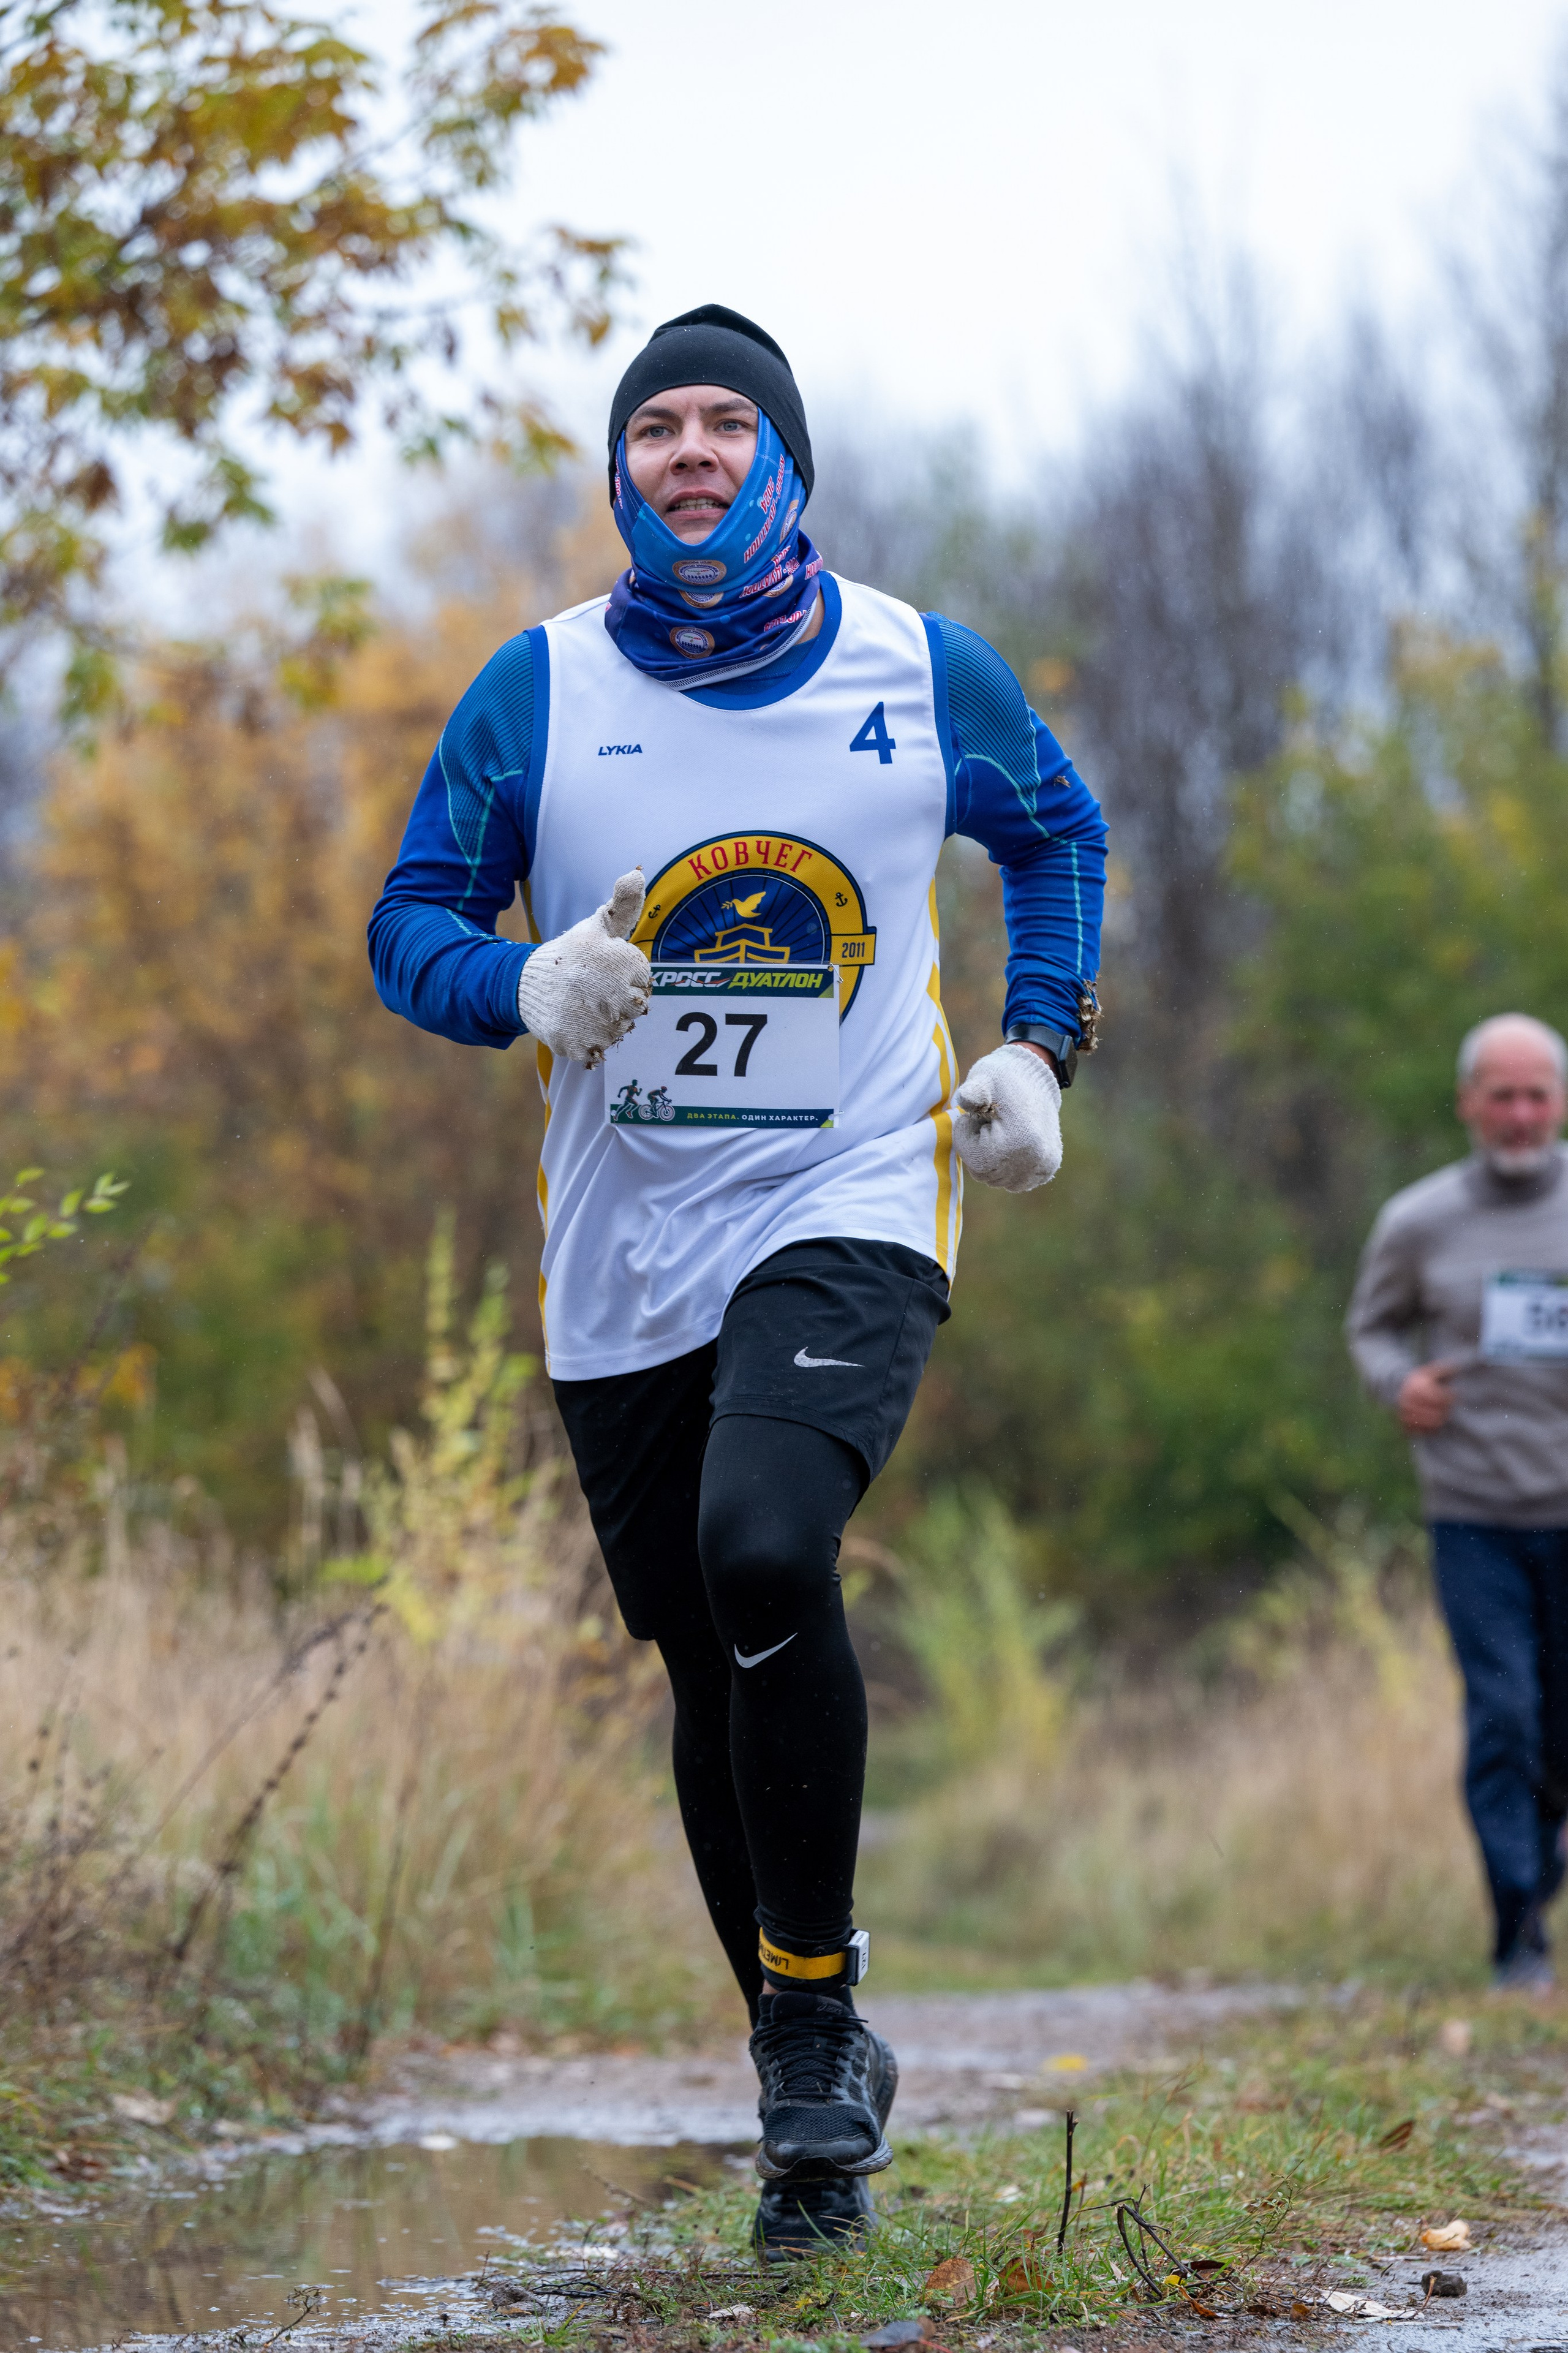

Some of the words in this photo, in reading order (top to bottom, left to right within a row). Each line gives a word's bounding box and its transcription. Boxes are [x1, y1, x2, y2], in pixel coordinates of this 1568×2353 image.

[760, 475, 775, 515] 2024
[598, 744, 643, 755] LYKIA
[849, 701, 897, 764] 4
[687, 839, 813, 881] КОВЧЕГ
[842, 942, 865, 958] 2011
[728, 972, 824, 990] ДУАТЛОН
[675, 1011, 768, 1078] 27
